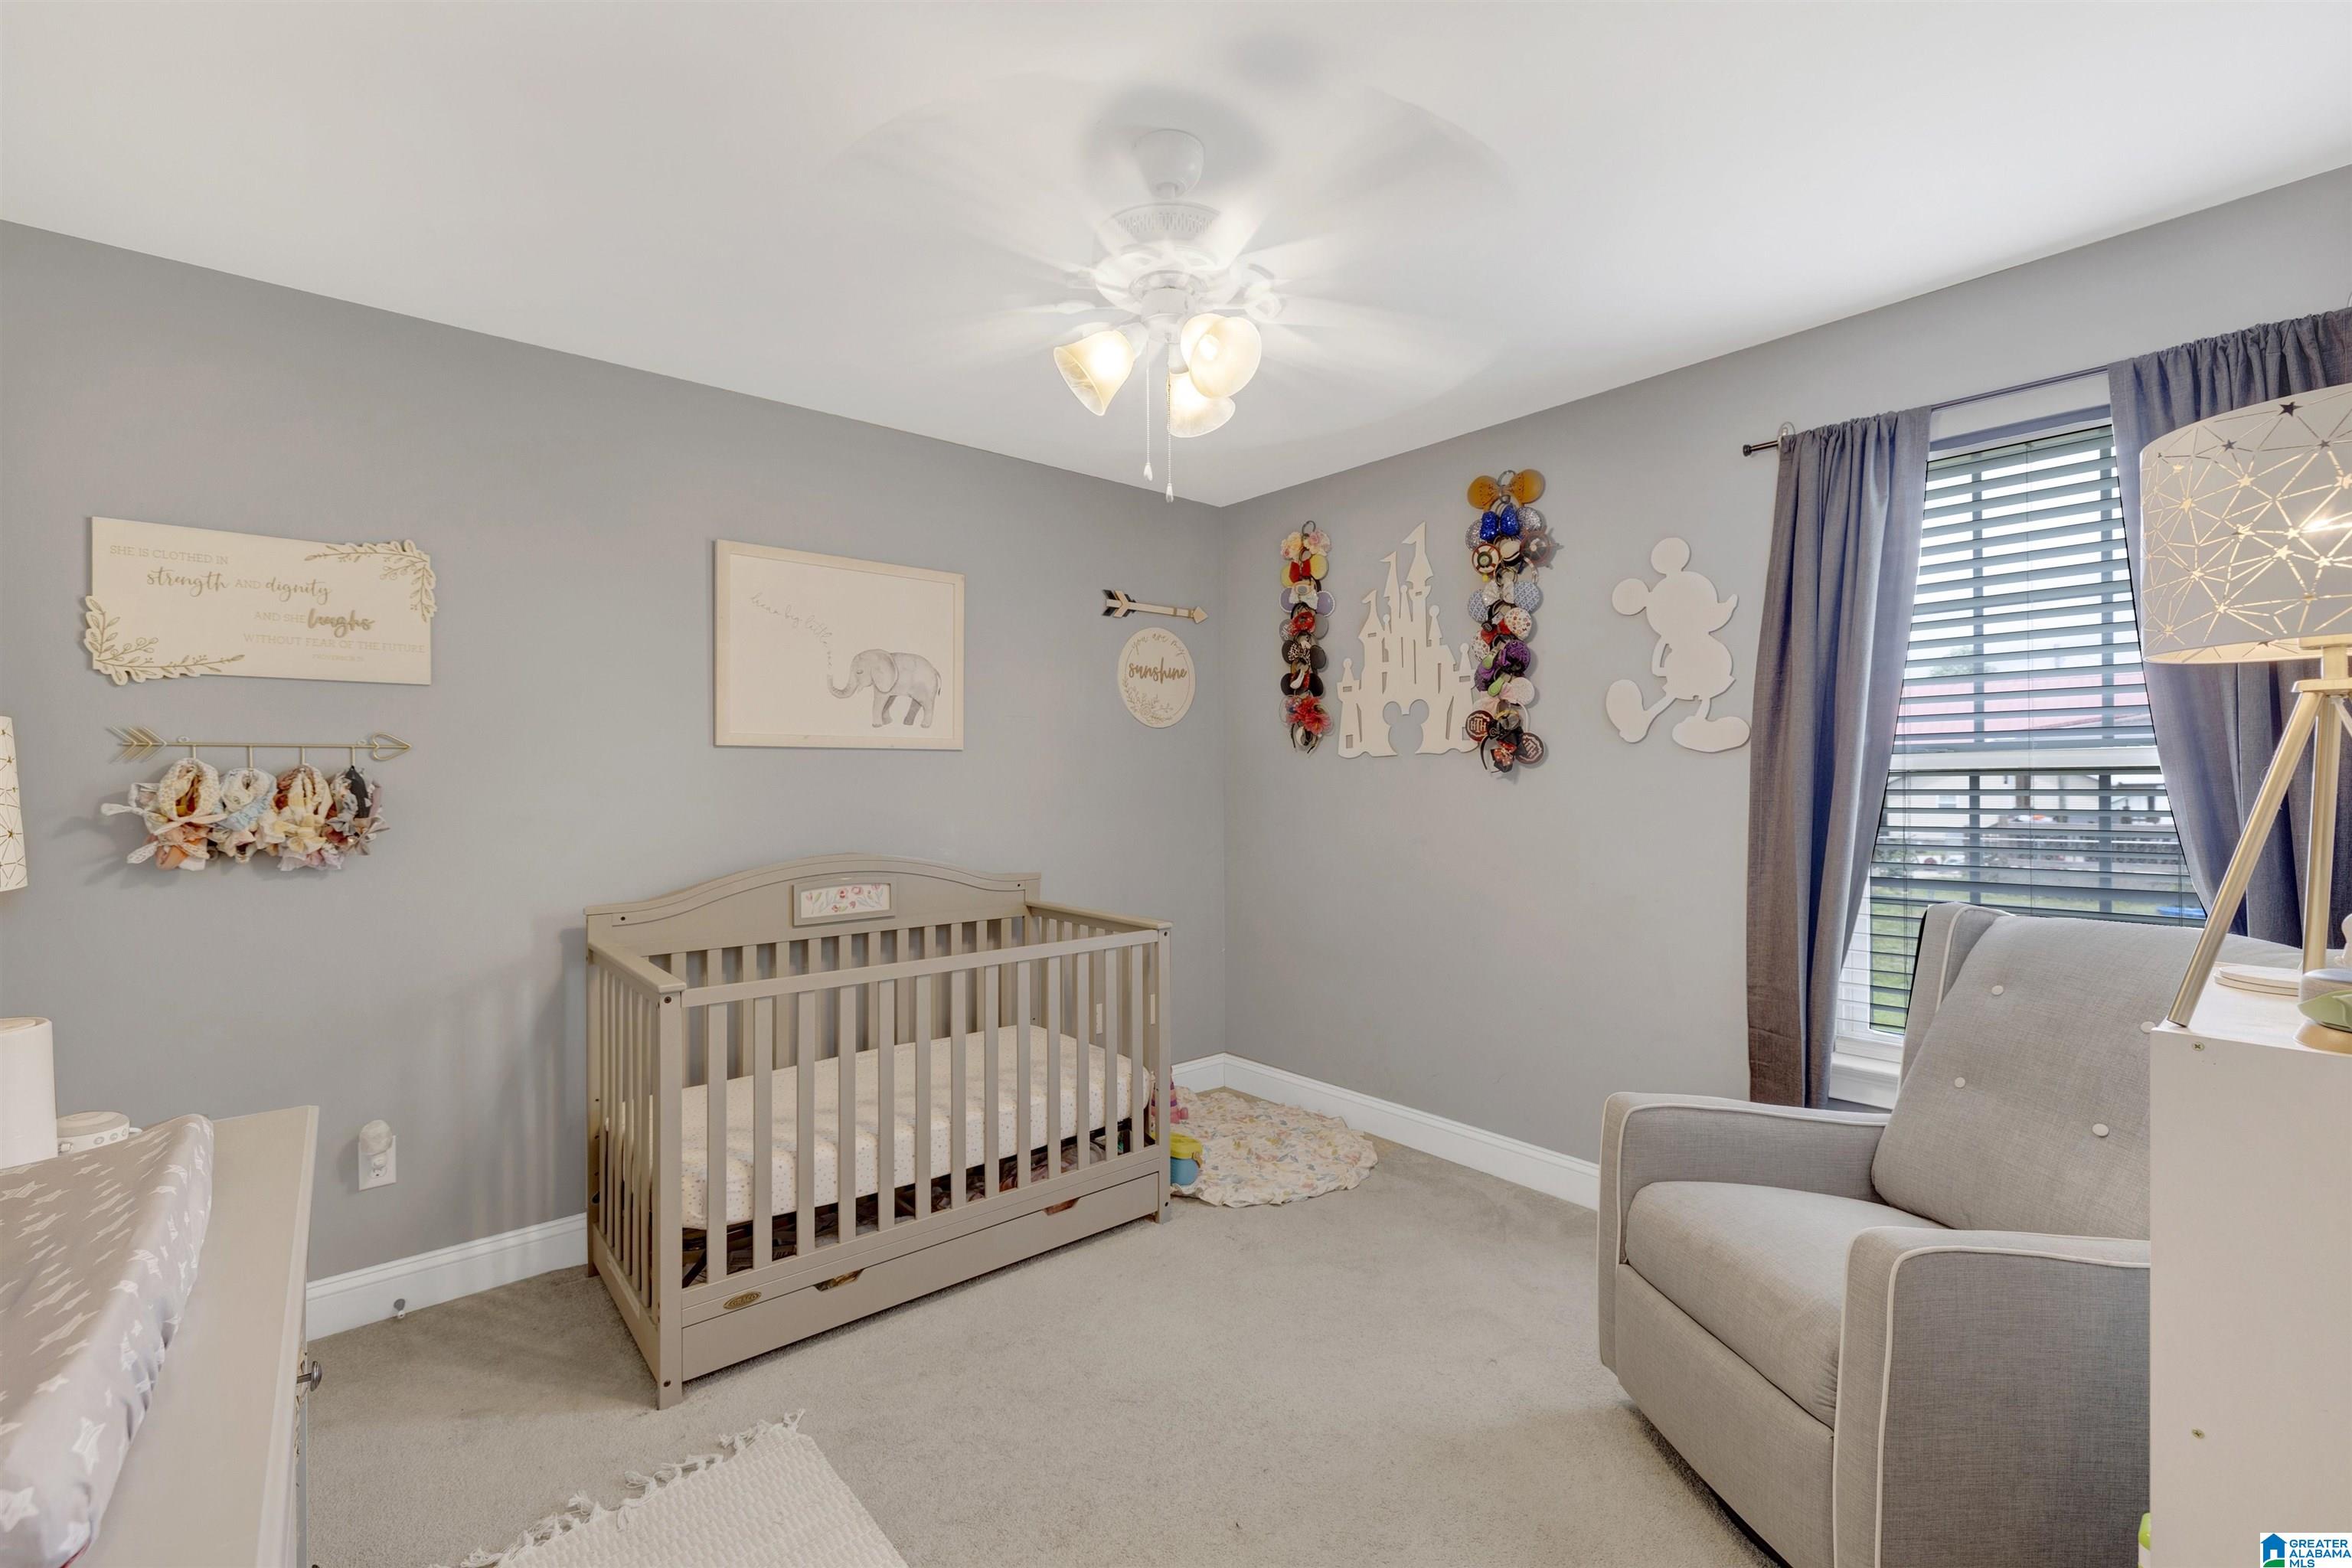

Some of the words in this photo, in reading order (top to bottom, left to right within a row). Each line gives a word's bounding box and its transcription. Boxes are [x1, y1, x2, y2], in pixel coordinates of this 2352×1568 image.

[109, 544, 136, 557] SHE
[139, 547, 149, 557] IS
[152, 549, 213, 564] CLOTHED
[216, 555, 229, 565] IN
[146, 567, 228, 597] strength
[235, 579, 261, 590] AND
[265, 577, 332, 605] dignity
[253, 611, 281, 622] AND
[283, 613, 307, 623] SHE
[308, 608, 375, 637] laughs
[243, 633, 302, 647] WITHOUT
[305, 637, 337, 648] FEAR
[338, 639, 356, 649] OF
[358, 641, 381, 651] THE
[382, 642, 426, 654] FUTURE
[1128, 657, 1187, 684] sunshine
